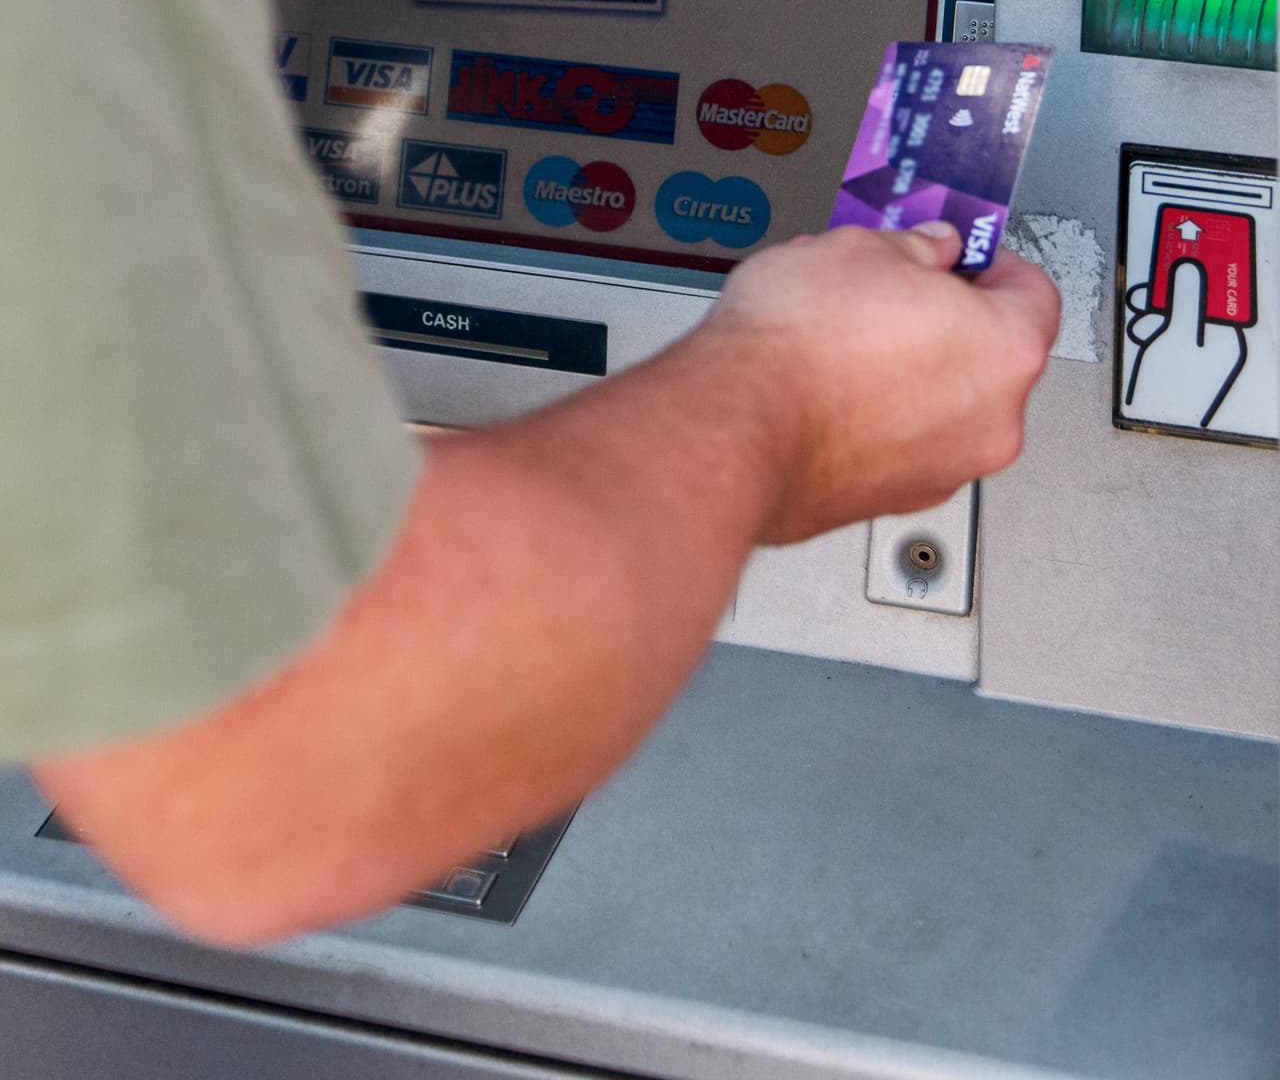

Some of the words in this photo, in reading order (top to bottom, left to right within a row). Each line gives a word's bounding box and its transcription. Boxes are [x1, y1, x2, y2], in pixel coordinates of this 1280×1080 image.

[345, 60, 414, 90] VISA
[700, 102, 810, 133] MasterCard
[1002, 71, 1037, 135] NatWest
[431, 175, 497, 209] PLUS
[534, 179, 625, 209] Maestro
[673, 195, 753, 225] Cirrus
[962, 213, 999, 265] VISA
[1227, 263, 1238, 288] YOUR
[1226, 288, 1237, 316] CARD
[422, 311, 470, 331] CASH
